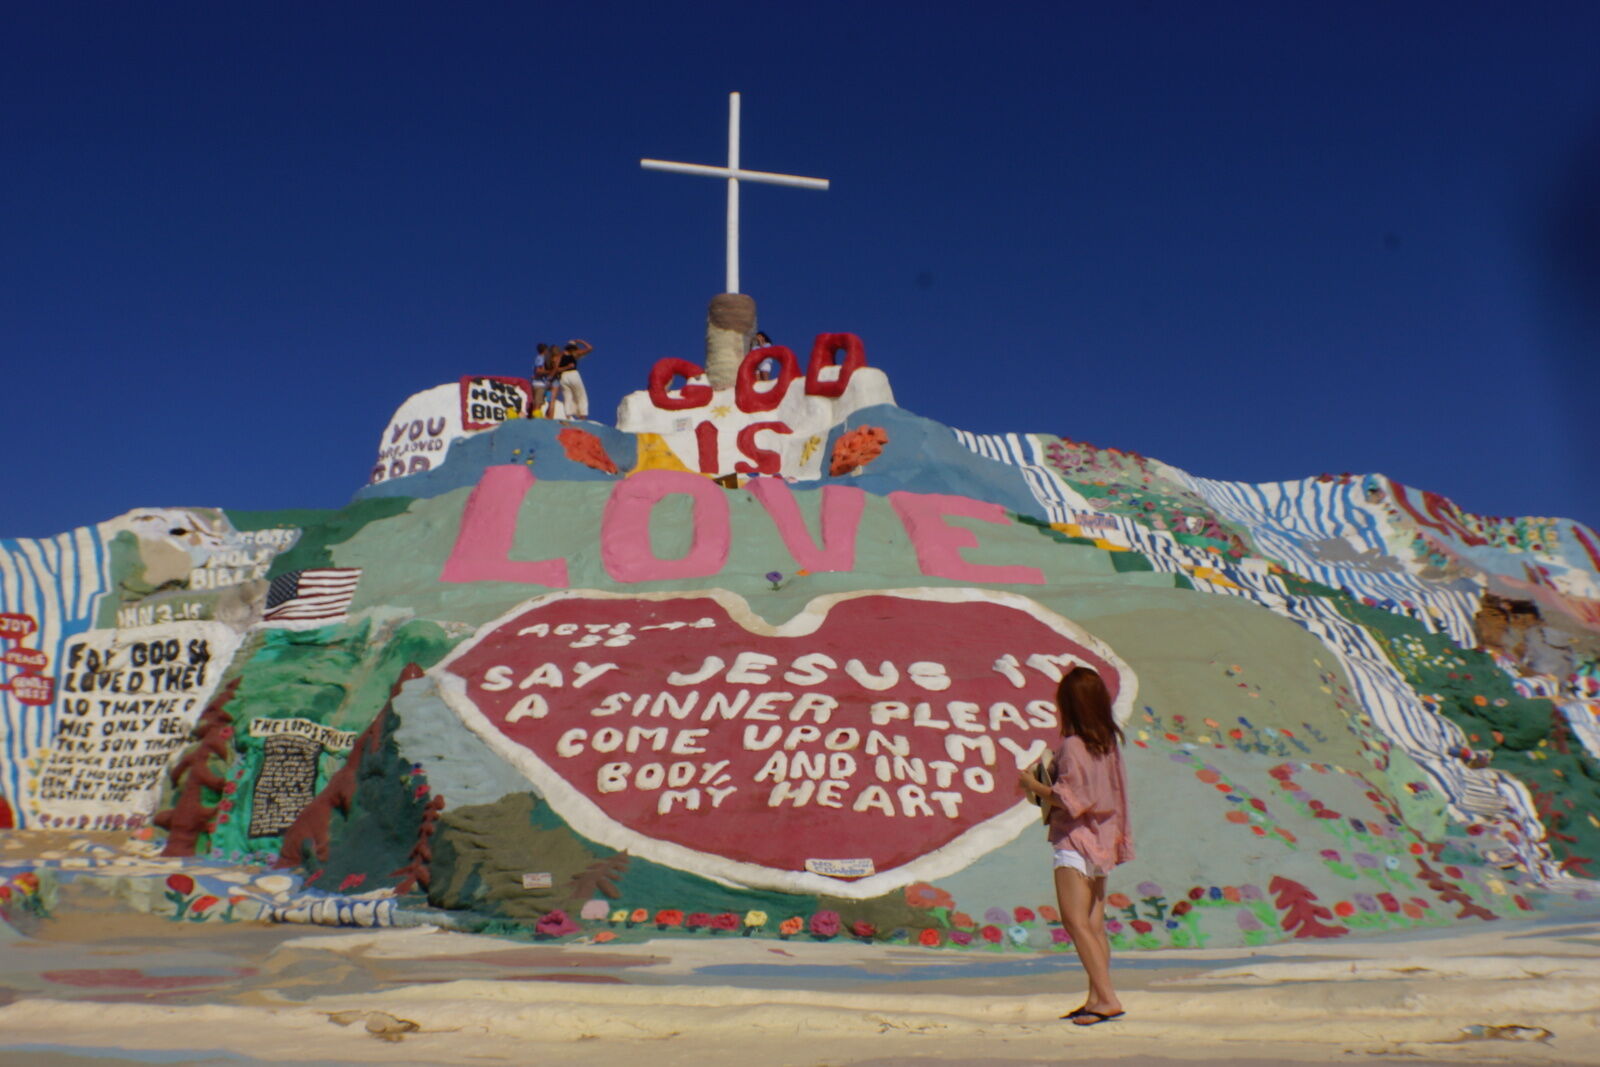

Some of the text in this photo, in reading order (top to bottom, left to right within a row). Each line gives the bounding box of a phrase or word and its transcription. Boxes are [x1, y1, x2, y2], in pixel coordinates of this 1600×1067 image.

[648, 332, 866, 414] GOD
[471, 402, 505, 422] BIB
[472, 388, 522, 414] HOLY
[391, 416, 446, 445] YOU
[695, 420, 794, 474] IS
[439, 464, 1047, 587] LOVE
[517, 622, 632, 638] ACTS
[131, 638, 180, 667] GOD
[64, 671, 144, 693] LOVED
[480, 661, 620, 692] SAY
[667, 652, 952, 691] JESUS
[99, 699, 154, 717] THAT
[505, 689, 1058, 733] A SINNER PLEAS
[58, 719, 94, 738] HIS
[102, 719, 154, 737] ONLY
[253, 718, 280, 733] THE
[320, 728, 356, 748] PRAYE
[101, 738, 138, 752] SON
[556, 724, 1047, 770] COME UPON MY
[754, 750, 857, 783] AND
[875, 755, 995, 794] INTO
[657, 779, 963, 819] MY HEART
